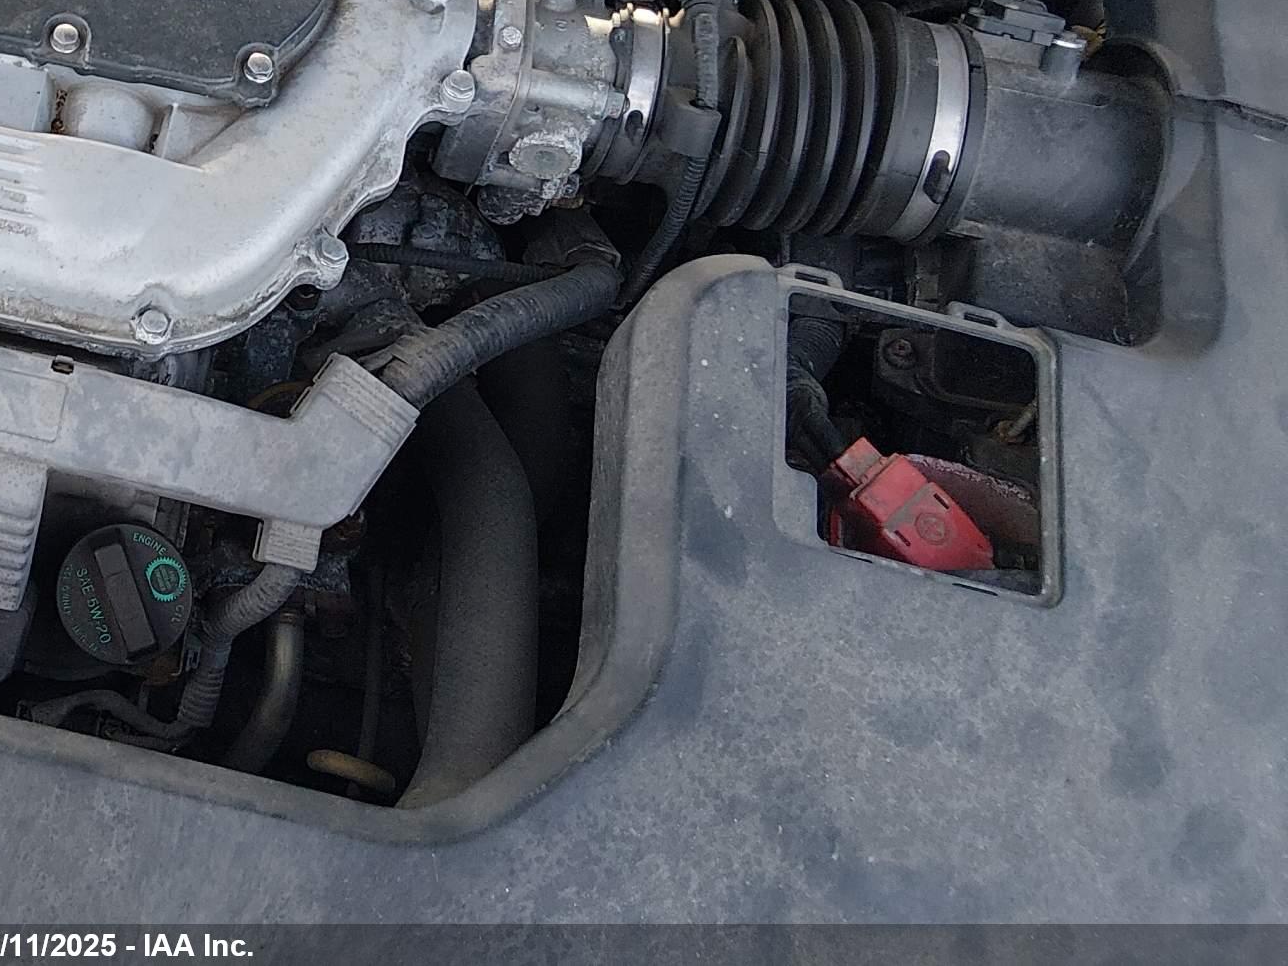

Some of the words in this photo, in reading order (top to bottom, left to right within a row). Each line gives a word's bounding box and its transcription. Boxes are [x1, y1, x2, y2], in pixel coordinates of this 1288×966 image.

[132, 532, 167, 556] ENGINE
[76, 567, 95, 596] SAE
[86, 597, 113, 644] 5W-20
